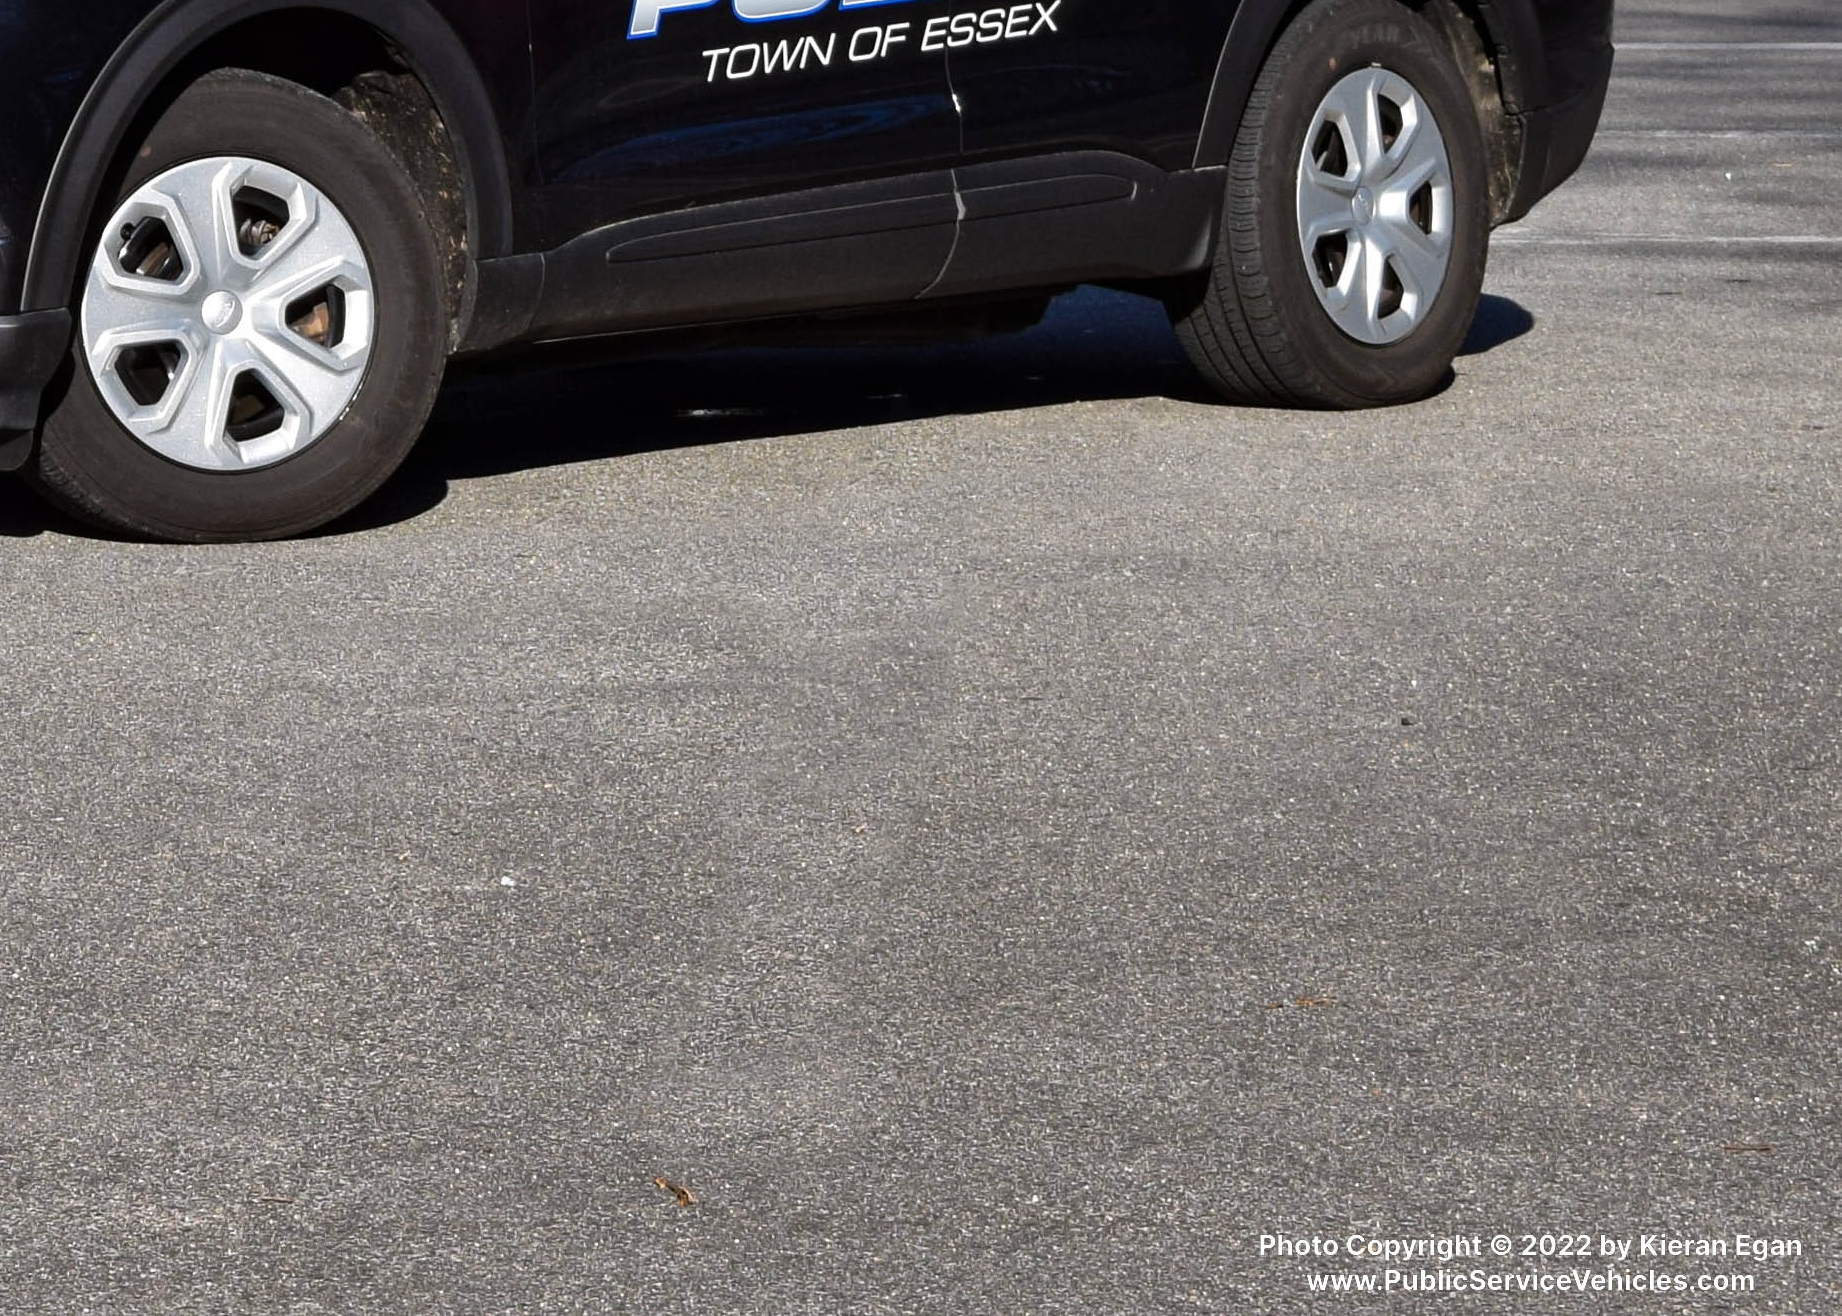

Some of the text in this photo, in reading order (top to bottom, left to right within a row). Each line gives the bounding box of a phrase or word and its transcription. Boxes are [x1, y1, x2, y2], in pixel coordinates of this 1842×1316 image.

[702, 0, 1061, 83] TOWN OF ESSEX
